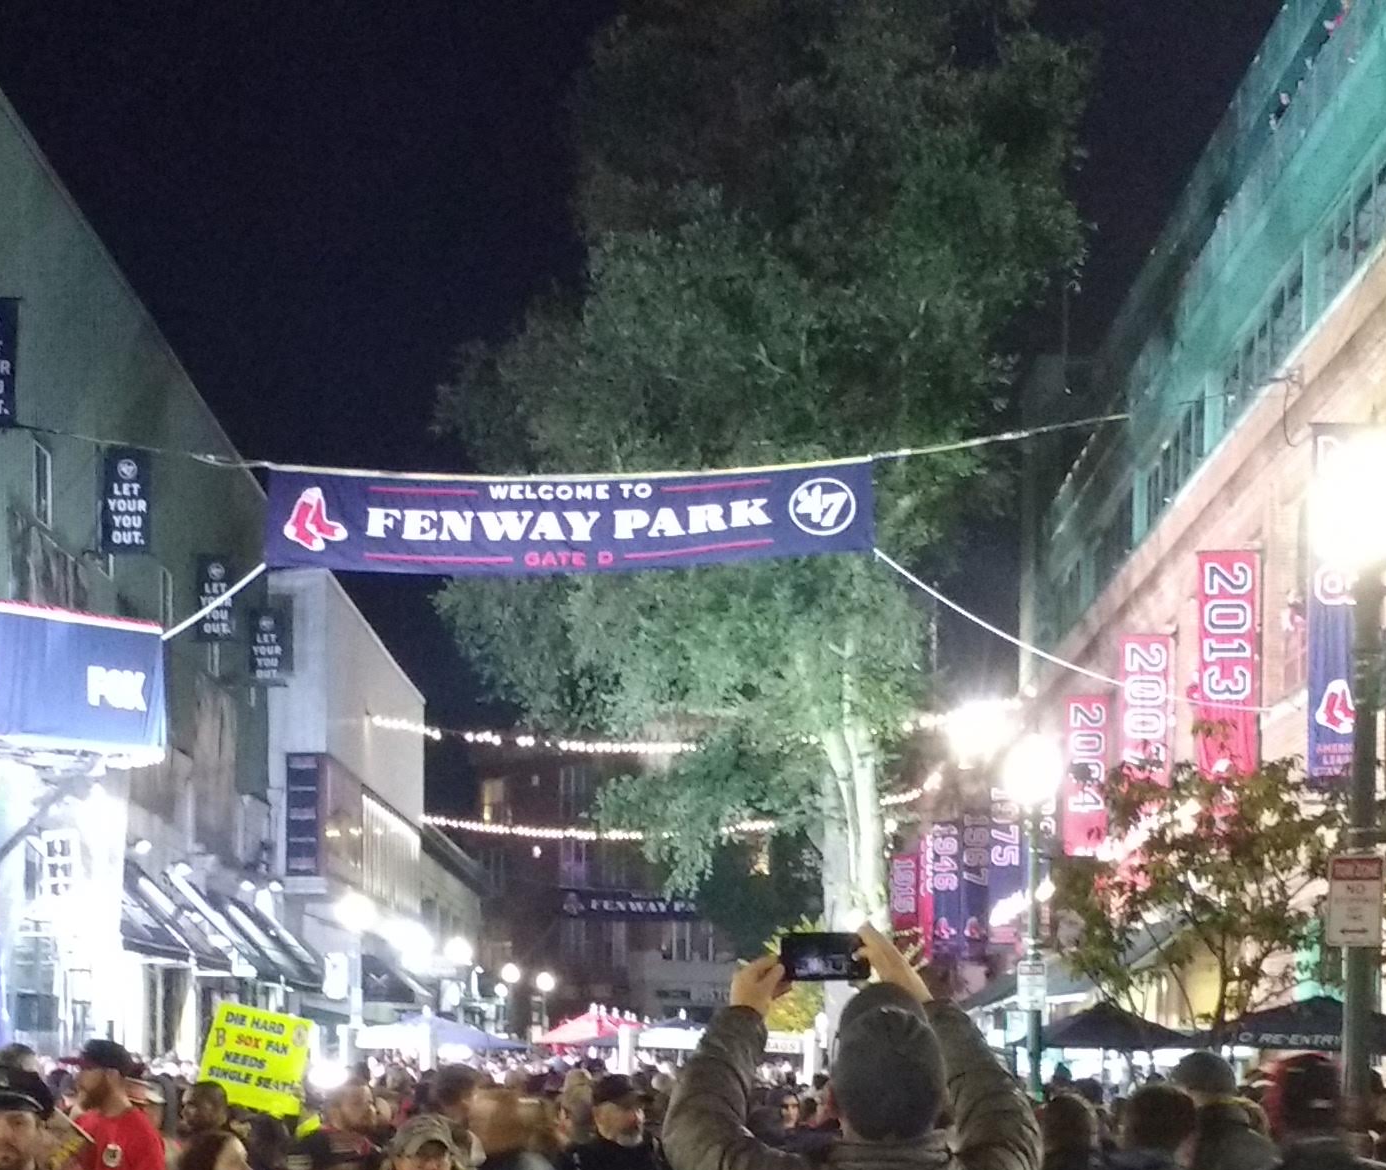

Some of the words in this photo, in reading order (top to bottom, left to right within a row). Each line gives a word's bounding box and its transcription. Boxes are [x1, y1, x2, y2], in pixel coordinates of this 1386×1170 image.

[113, 483, 140, 496] LET
[489, 483, 609, 501] WELCOME
[620, 481, 653, 499] TO
[108, 499, 147, 513] YOUR
[113, 516, 142, 529] YOU
[365, 506, 601, 542] FENWAY
[612, 497, 773, 540] PARK
[112, 531, 145, 545] OUT.
[524, 550, 586, 567] GATE
[598, 550, 613, 566] D
[204, 582, 227, 594] LET
[256, 633, 277, 644] LET
[1202, 562, 1253, 701] 2013
[253, 645, 282, 656] YOUR
[256, 657, 279, 667] YOU
[87, 665, 147, 712] FOX
[933, 823, 959, 891] 1946
[963, 813, 989, 887] 1967
[225, 1011, 247, 1027] DIE
[251, 1016, 285, 1036] HARD
[235, 1033, 262, 1050] SOX
[265, 1039, 289, 1056] FAN
[222, 1051, 266, 1070] NEEDS
[208, 1065, 253, 1084] SINGLE
